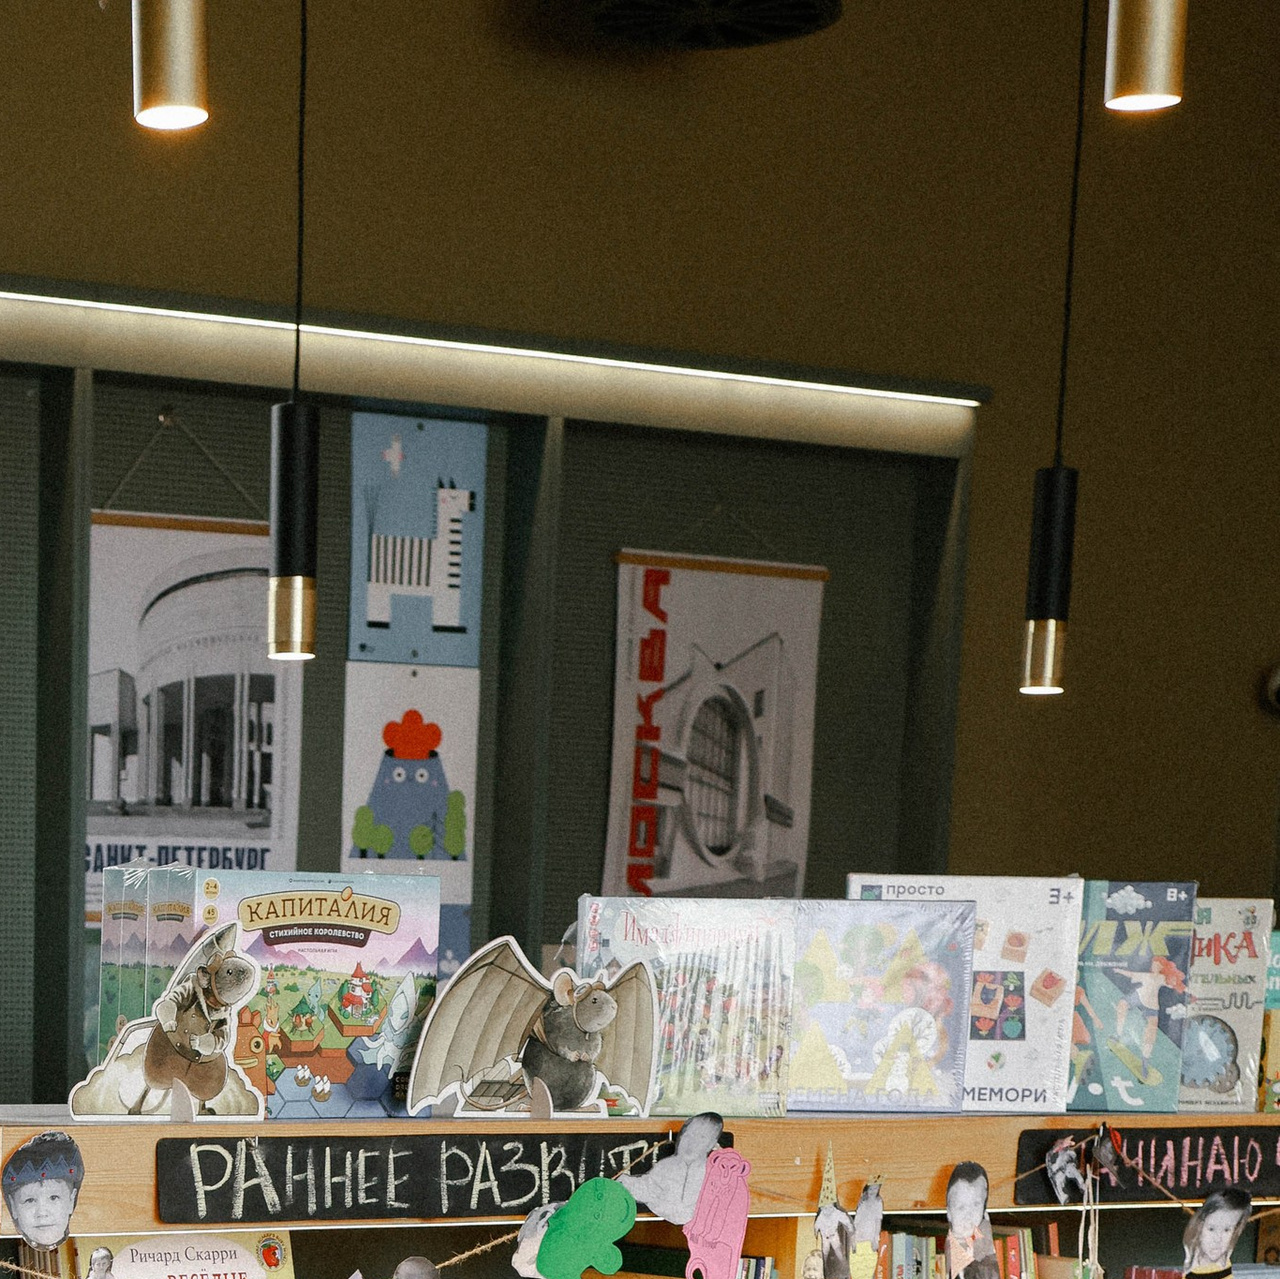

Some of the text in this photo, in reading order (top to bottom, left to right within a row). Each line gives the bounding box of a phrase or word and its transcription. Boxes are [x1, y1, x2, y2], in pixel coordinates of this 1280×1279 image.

[205, 883, 218, 891] 2-4
[886, 883, 946, 898] просто
[1049, 887, 1075, 905] 3+
[1166, 889, 1187, 902] 8+
[247, 895, 393, 927] КАПИТАЛИЯ
[269, 926, 365, 941] СТИХИЙНОЕ КОРОЛЕВСТВО
[962, 1086, 1048, 1104] МЕМОРИ
[189, 1139, 414, 1220] РАННЕЕ
[130, 1246, 238, 1265] Ричард Скарри
